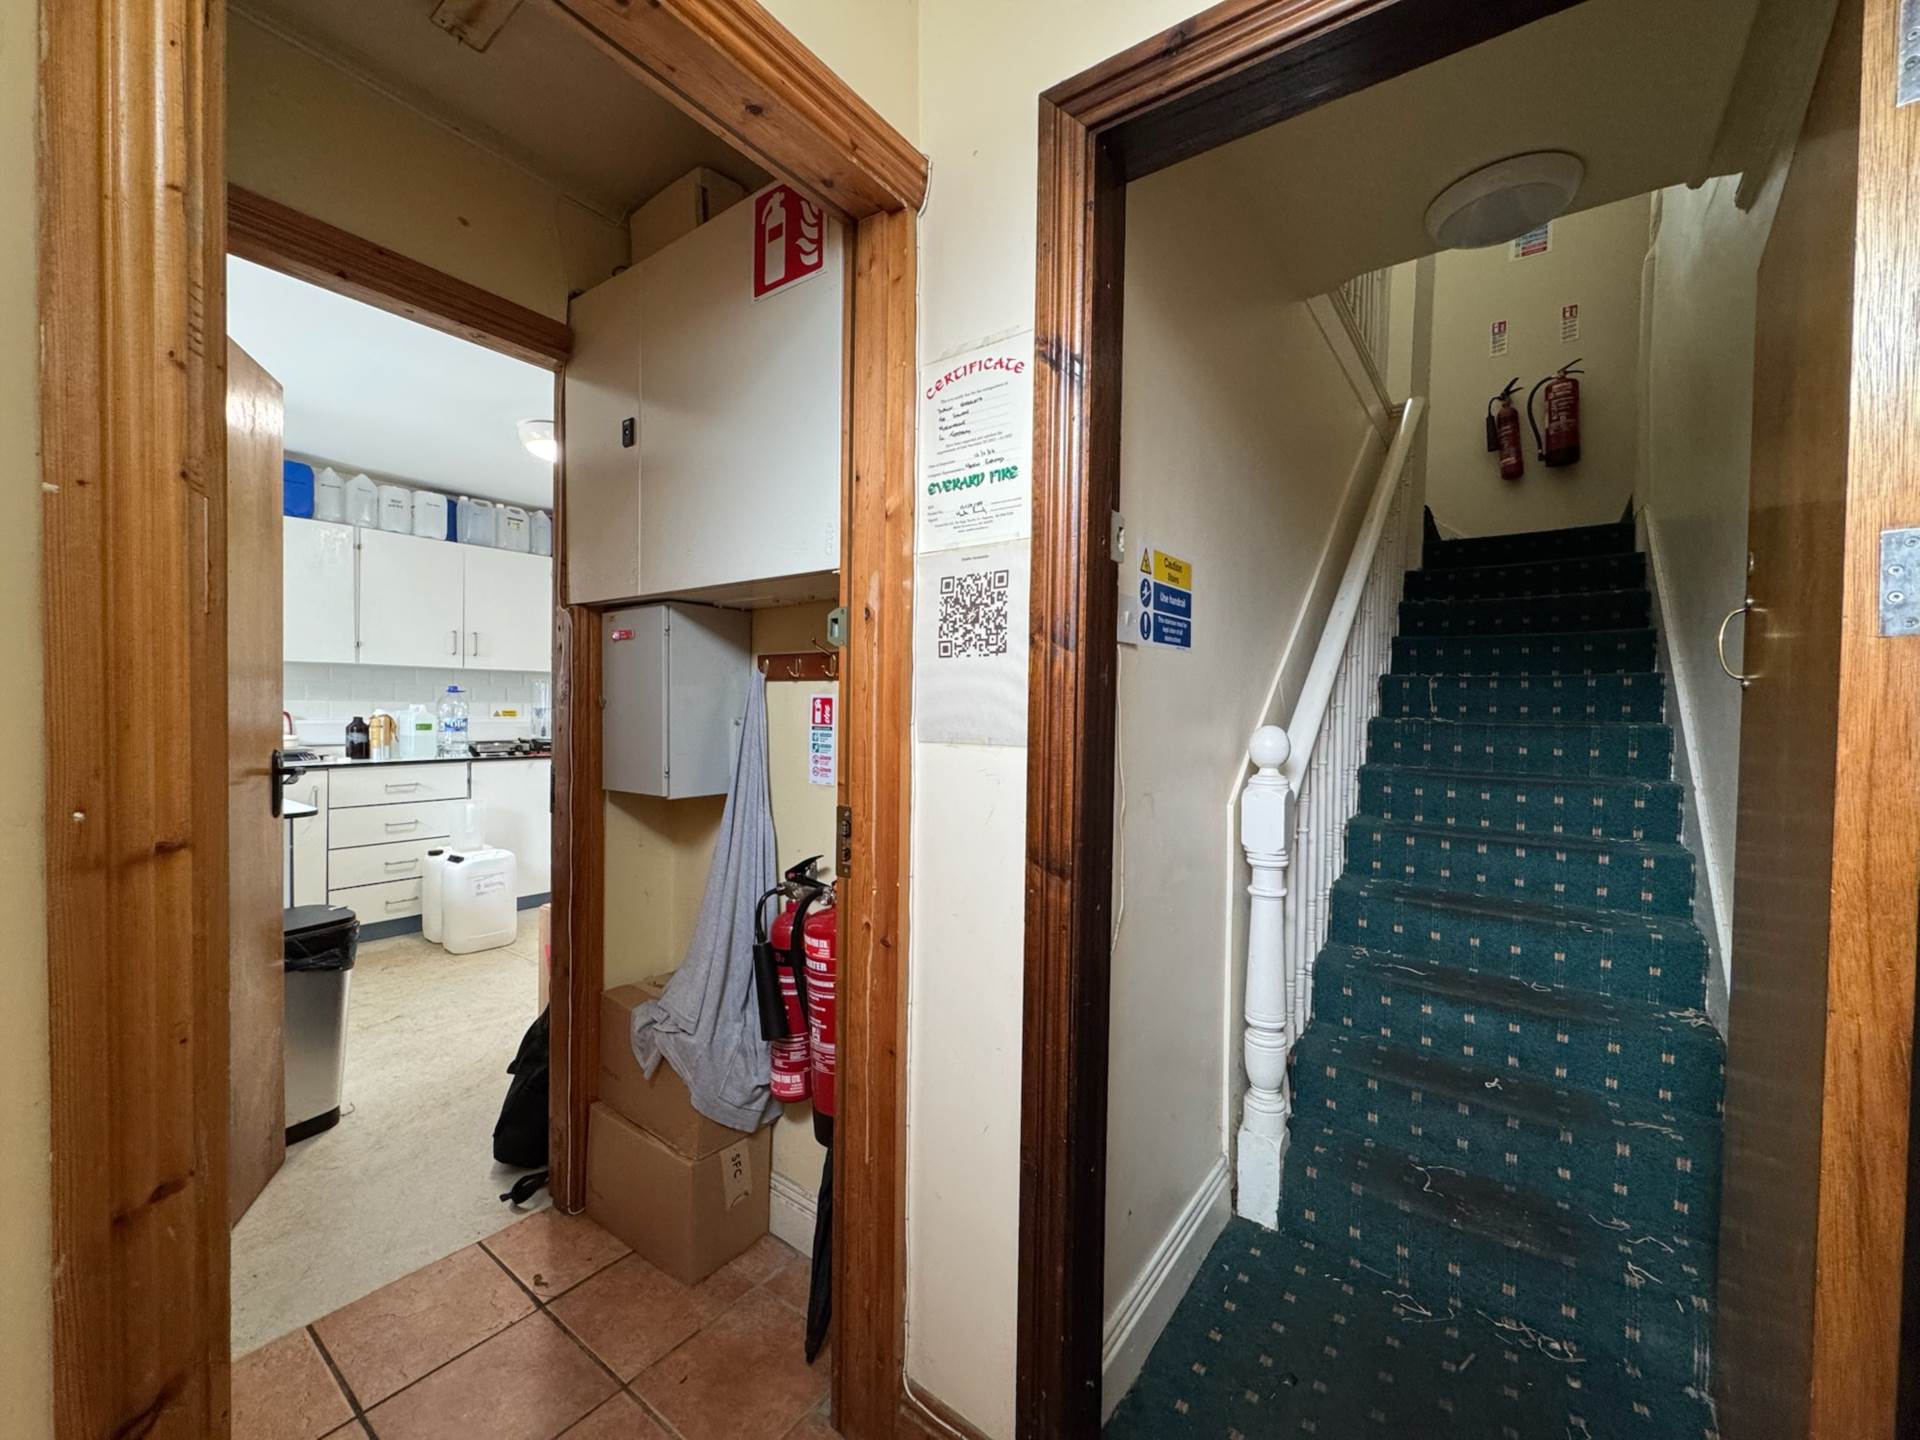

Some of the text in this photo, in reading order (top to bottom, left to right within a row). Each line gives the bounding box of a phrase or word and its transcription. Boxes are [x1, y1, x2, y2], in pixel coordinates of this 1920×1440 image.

[926, 356, 1025, 399] CERTIFICATE
[927, 465, 1019, 496] EVERARD FIRE
